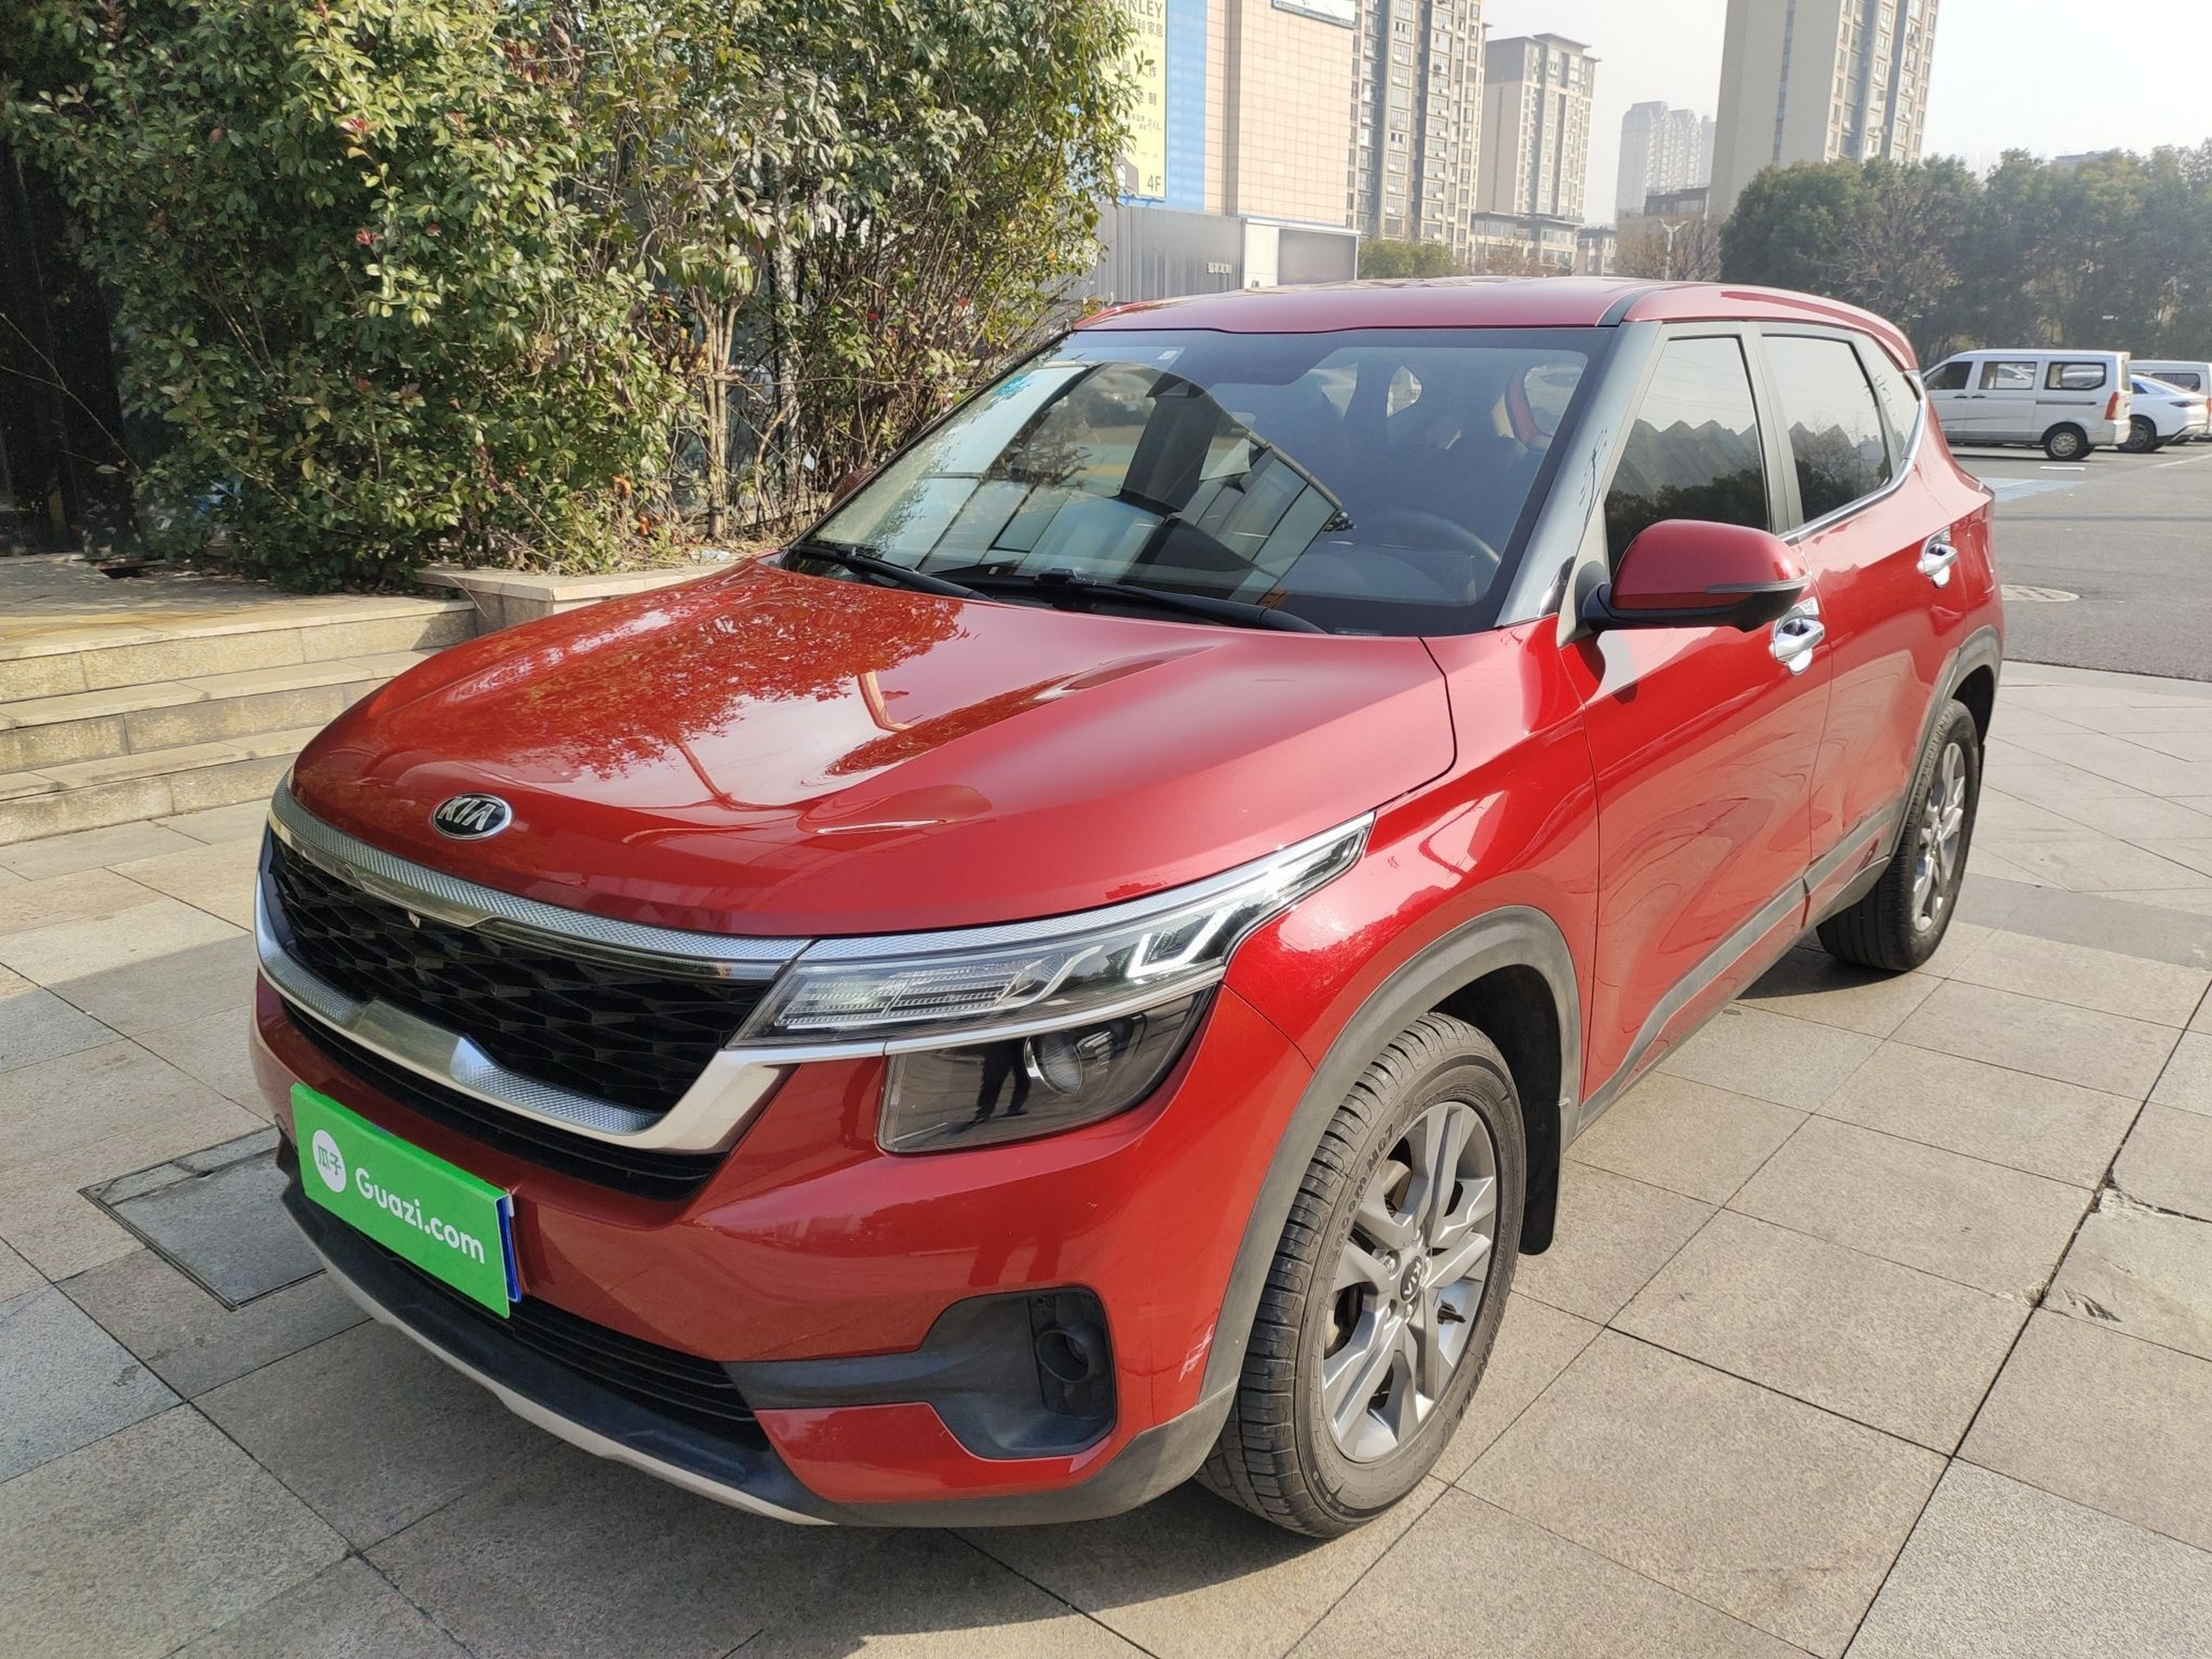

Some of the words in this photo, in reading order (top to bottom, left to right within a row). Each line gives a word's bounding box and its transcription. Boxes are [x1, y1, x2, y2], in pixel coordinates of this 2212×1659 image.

[1146, 174, 1162, 191] 4F
[437, 796, 496, 831] KIA
[317, 1145, 342, 1176] 瓜子
[355, 1167, 485, 1264] Guazi.com
